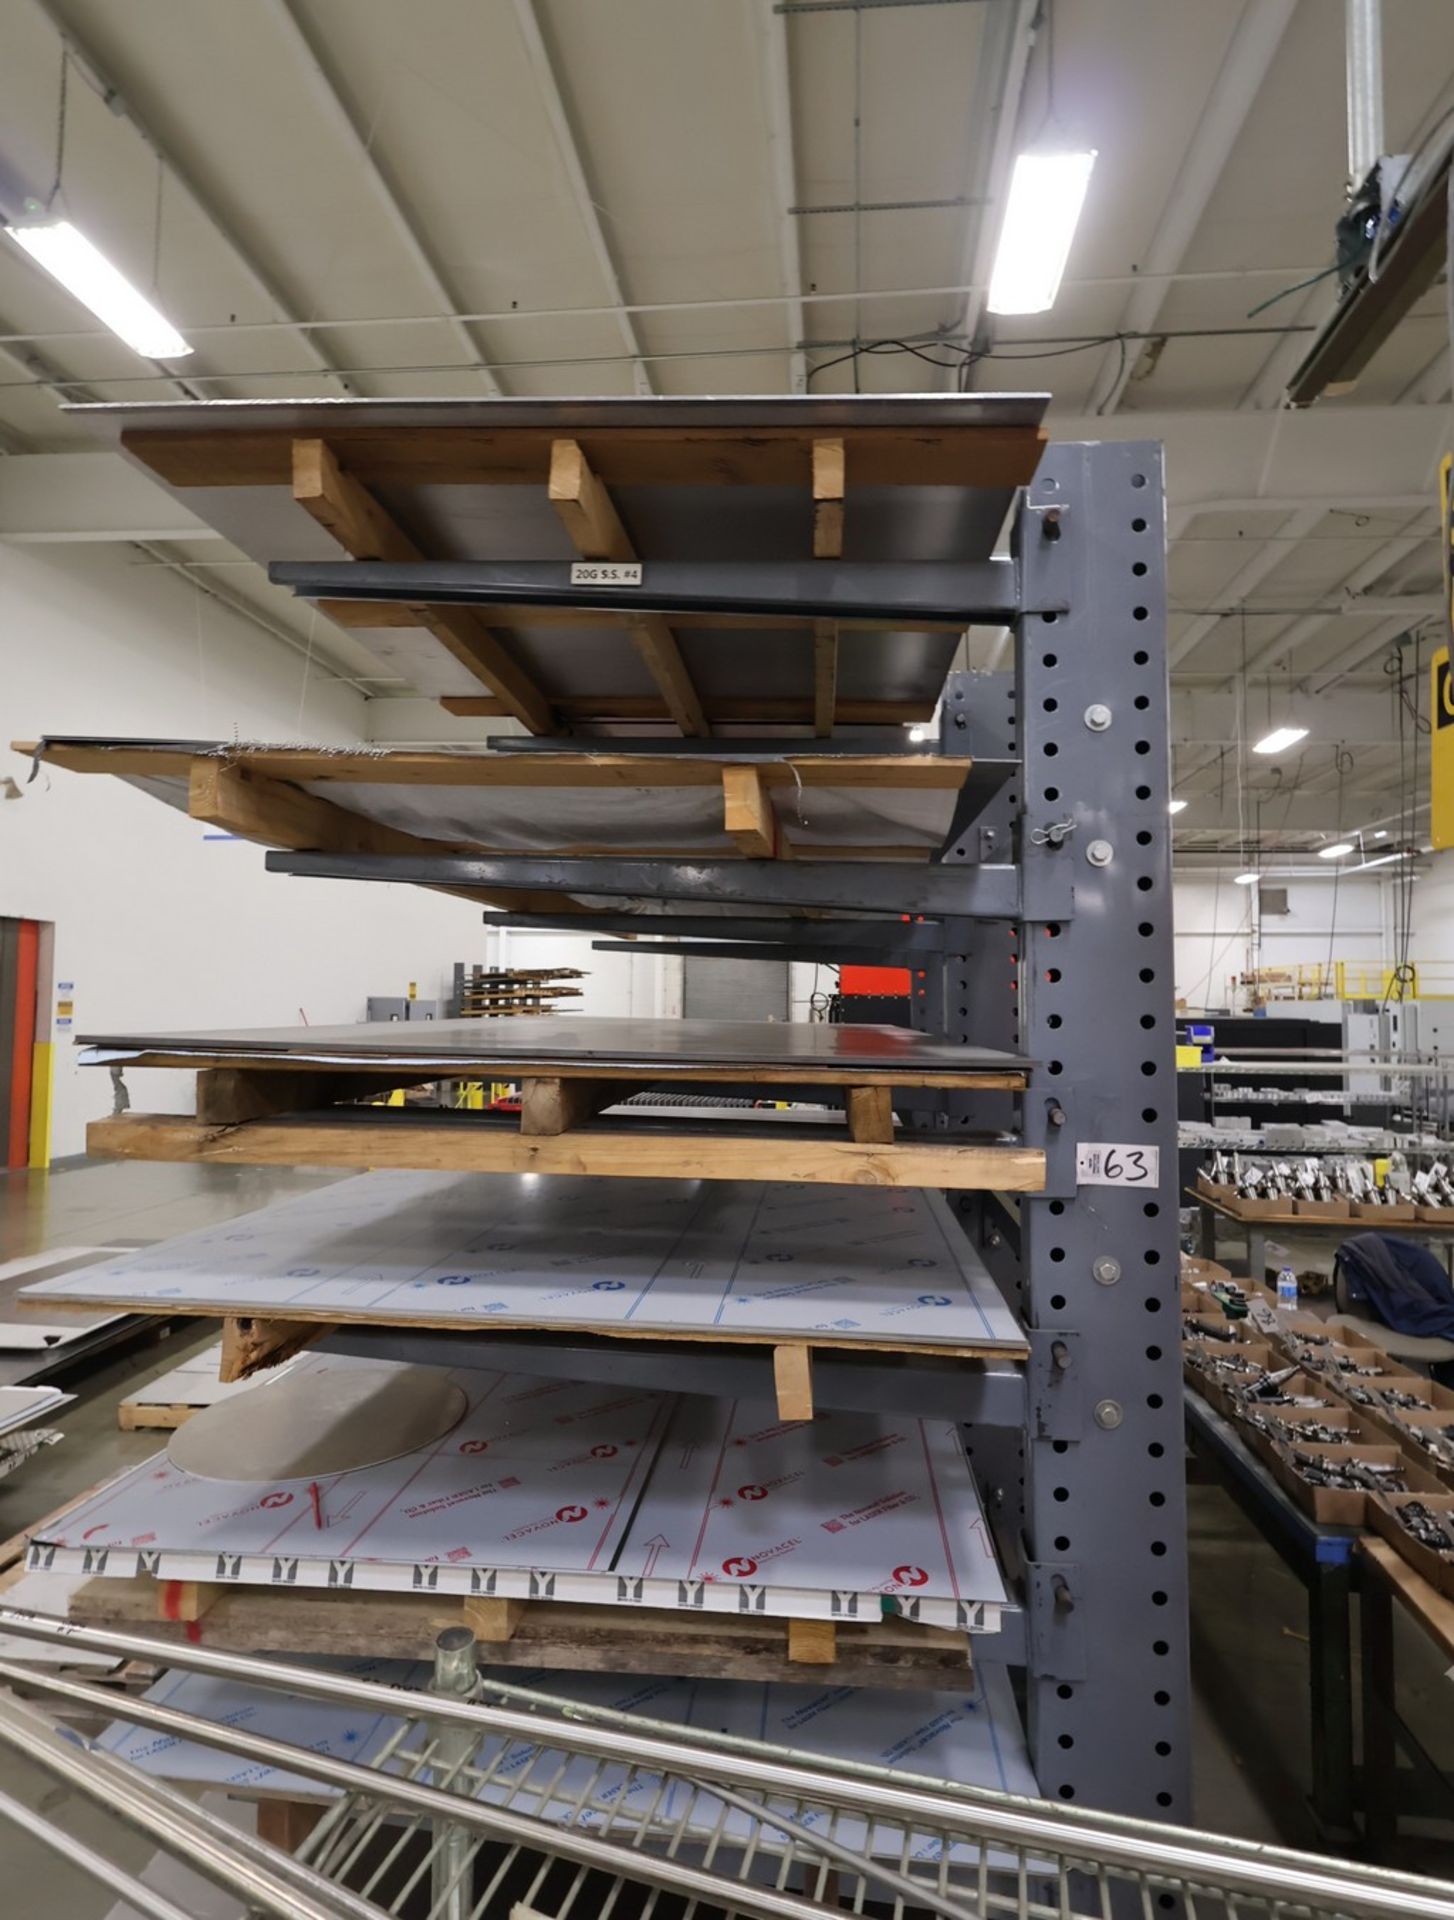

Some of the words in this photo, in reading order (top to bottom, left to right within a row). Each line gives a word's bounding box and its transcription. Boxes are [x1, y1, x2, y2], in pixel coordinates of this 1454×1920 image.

[575, 569, 598, 580] 20G
[624, 569, 638, 579] #4
[1103, 1148, 1149, 1182] 63
[750, 1536, 802, 1561] NOVACEL
